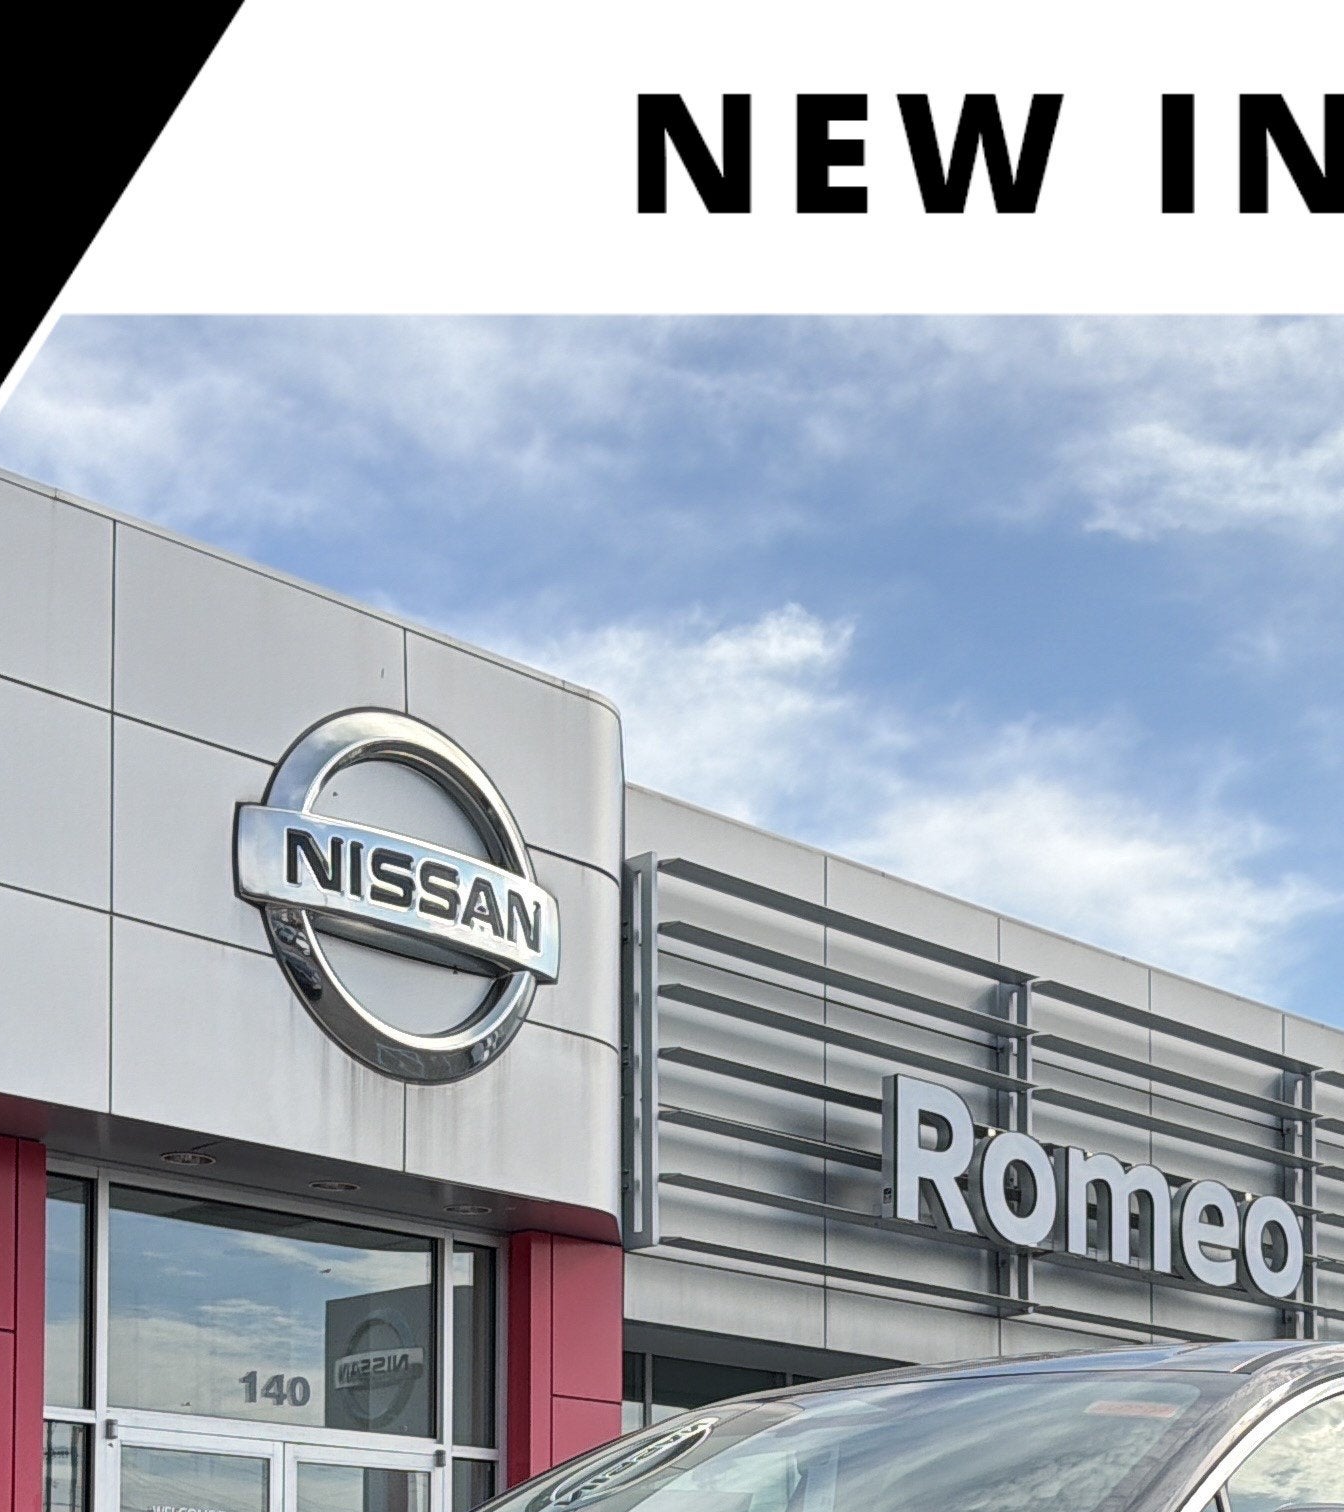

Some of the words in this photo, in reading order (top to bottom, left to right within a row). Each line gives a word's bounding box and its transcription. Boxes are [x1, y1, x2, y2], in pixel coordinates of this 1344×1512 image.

[286, 828, 542, 953] NISSAN
[883, 1073, 1304, 1299] Romeo
[239, 1371, 311, 1407] 140
